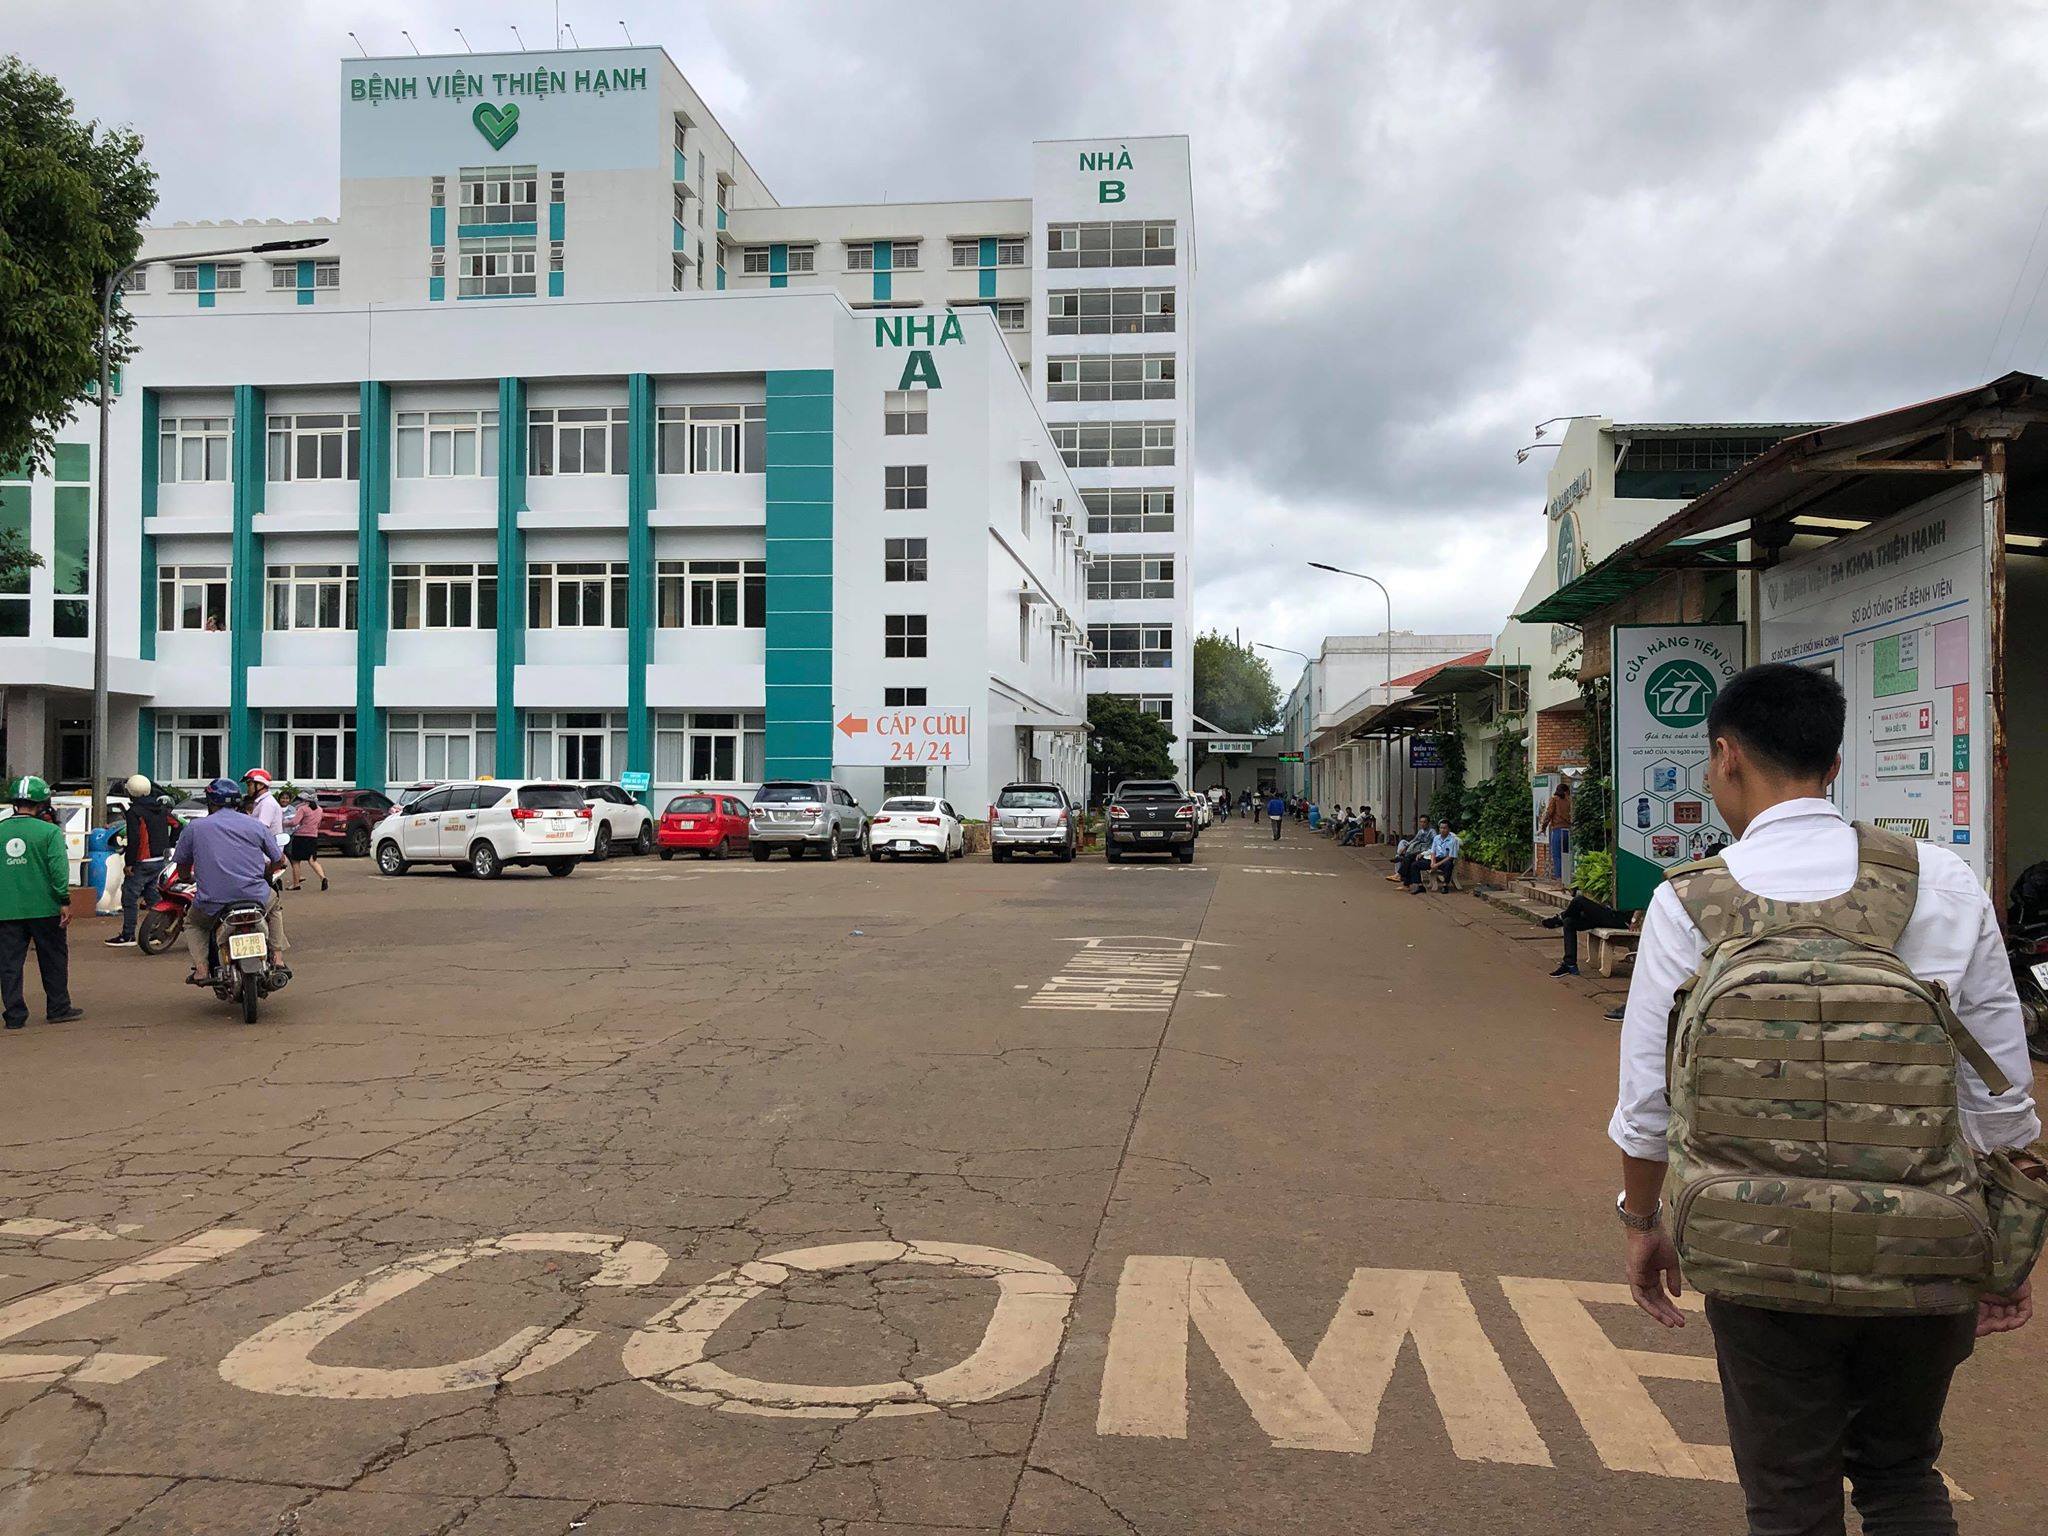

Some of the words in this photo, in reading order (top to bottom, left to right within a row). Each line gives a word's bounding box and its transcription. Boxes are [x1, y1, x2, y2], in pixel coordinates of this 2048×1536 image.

[350, 72, 418, 106] BỆNH
[427, 69, 483, 103] VIỆN
[492, 66, 566, 100] THIỆN
[575, 67, 647, 97] HẠNH
[1080, 144, 1134, 171] NHÀ
[1099, 180, 1127, 204] B
[875, 307, 966, 347] NHÀ
[898, 350, 943, 390] A
[1846, 549, 1874, 580] KHOA
[1876, 533, 1909, 567] THIỆN
[1911, 519, 1946, 555] HẠNH
[1894, 585, 1908, 611] THỂ
[1909, 585, 1931, 609] BỆNH
[1932, 577, 1953, 600] VIỆN
[1625, 655, 1649, 683] CỬA
[1646, 636, 1690, 656] HÀNG
[1693, 638, 1723, 661] TIỆN
[1660, 681, 1702, 713] 77
[876, 711, 917, 736] CẤP
[922, 711, 966, 736] CỨU
[890, 739, 952, 762] 24/24
[6, 856, 28, 866] Grab
